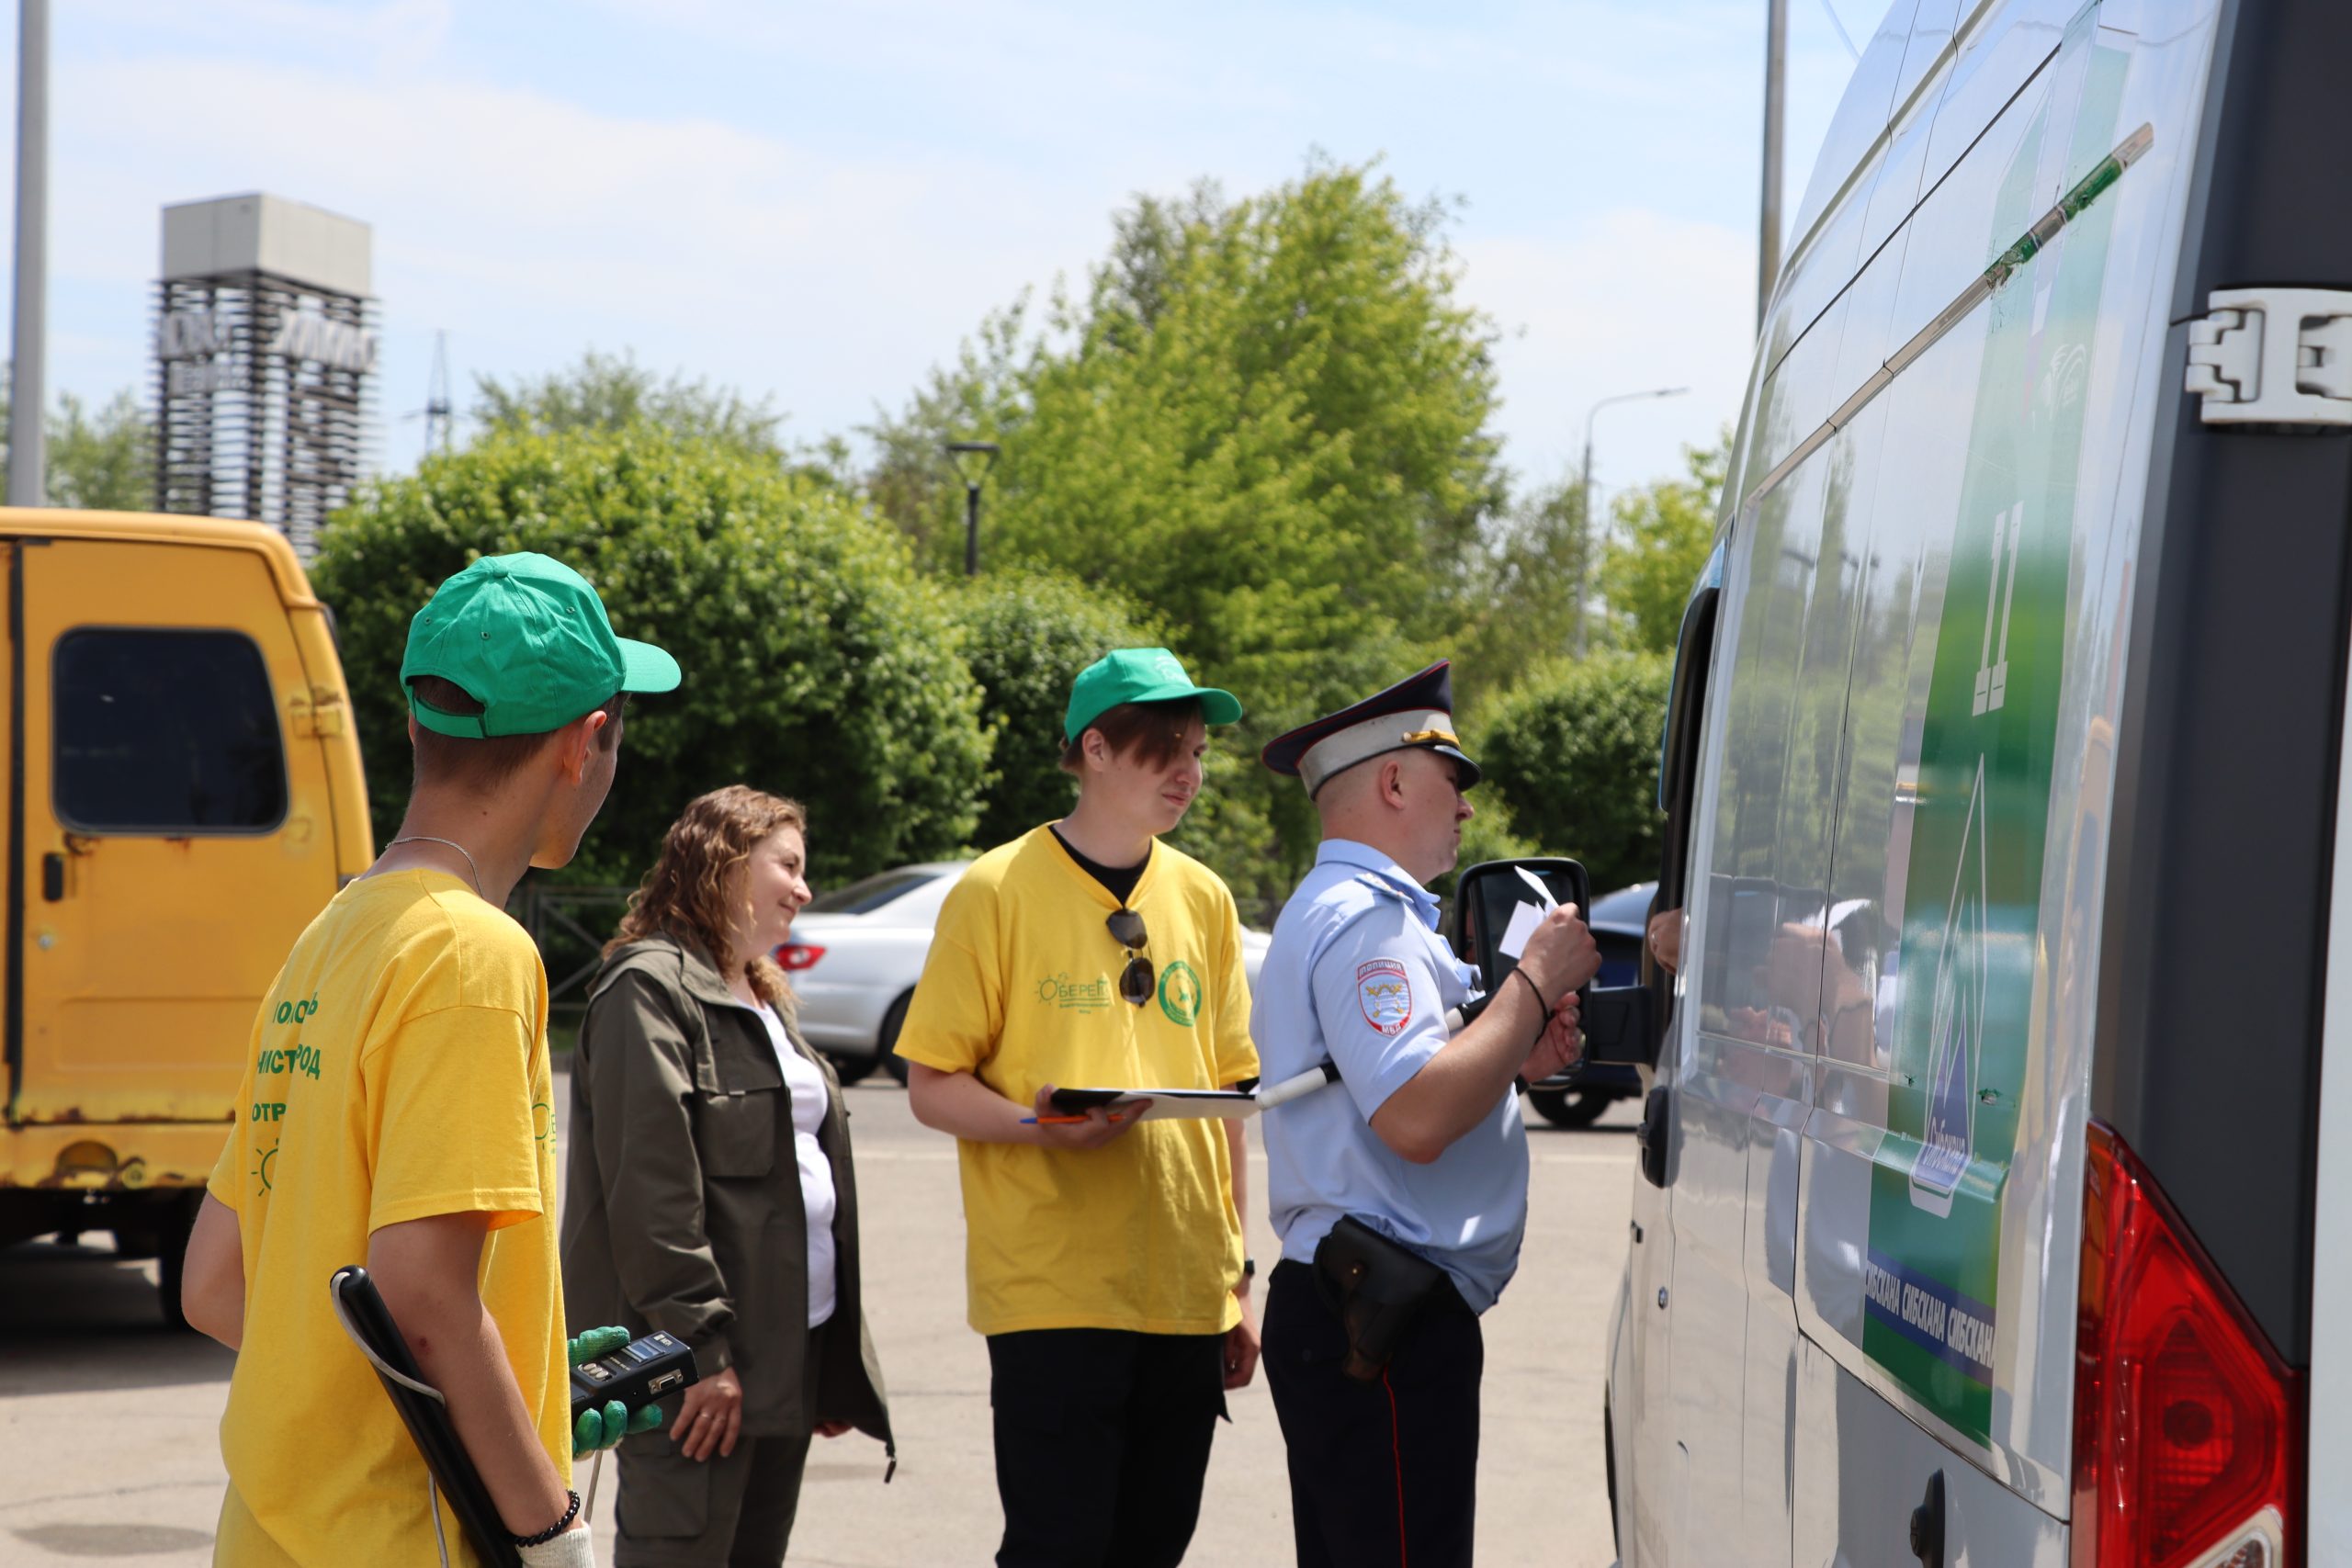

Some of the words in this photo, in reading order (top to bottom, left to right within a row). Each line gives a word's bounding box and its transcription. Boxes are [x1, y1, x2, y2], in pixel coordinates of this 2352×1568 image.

[1360, 960, 1404, 976] ПОЛИЦИЯ
[1382, 1023, 1403, 1036] МВД
[252, 1102, 287, 1122] ОТР
[1902, 1283, 1947, 1343] СИБСКАНА
[1947, 1307, 1996, 1370] СИБСКАН
